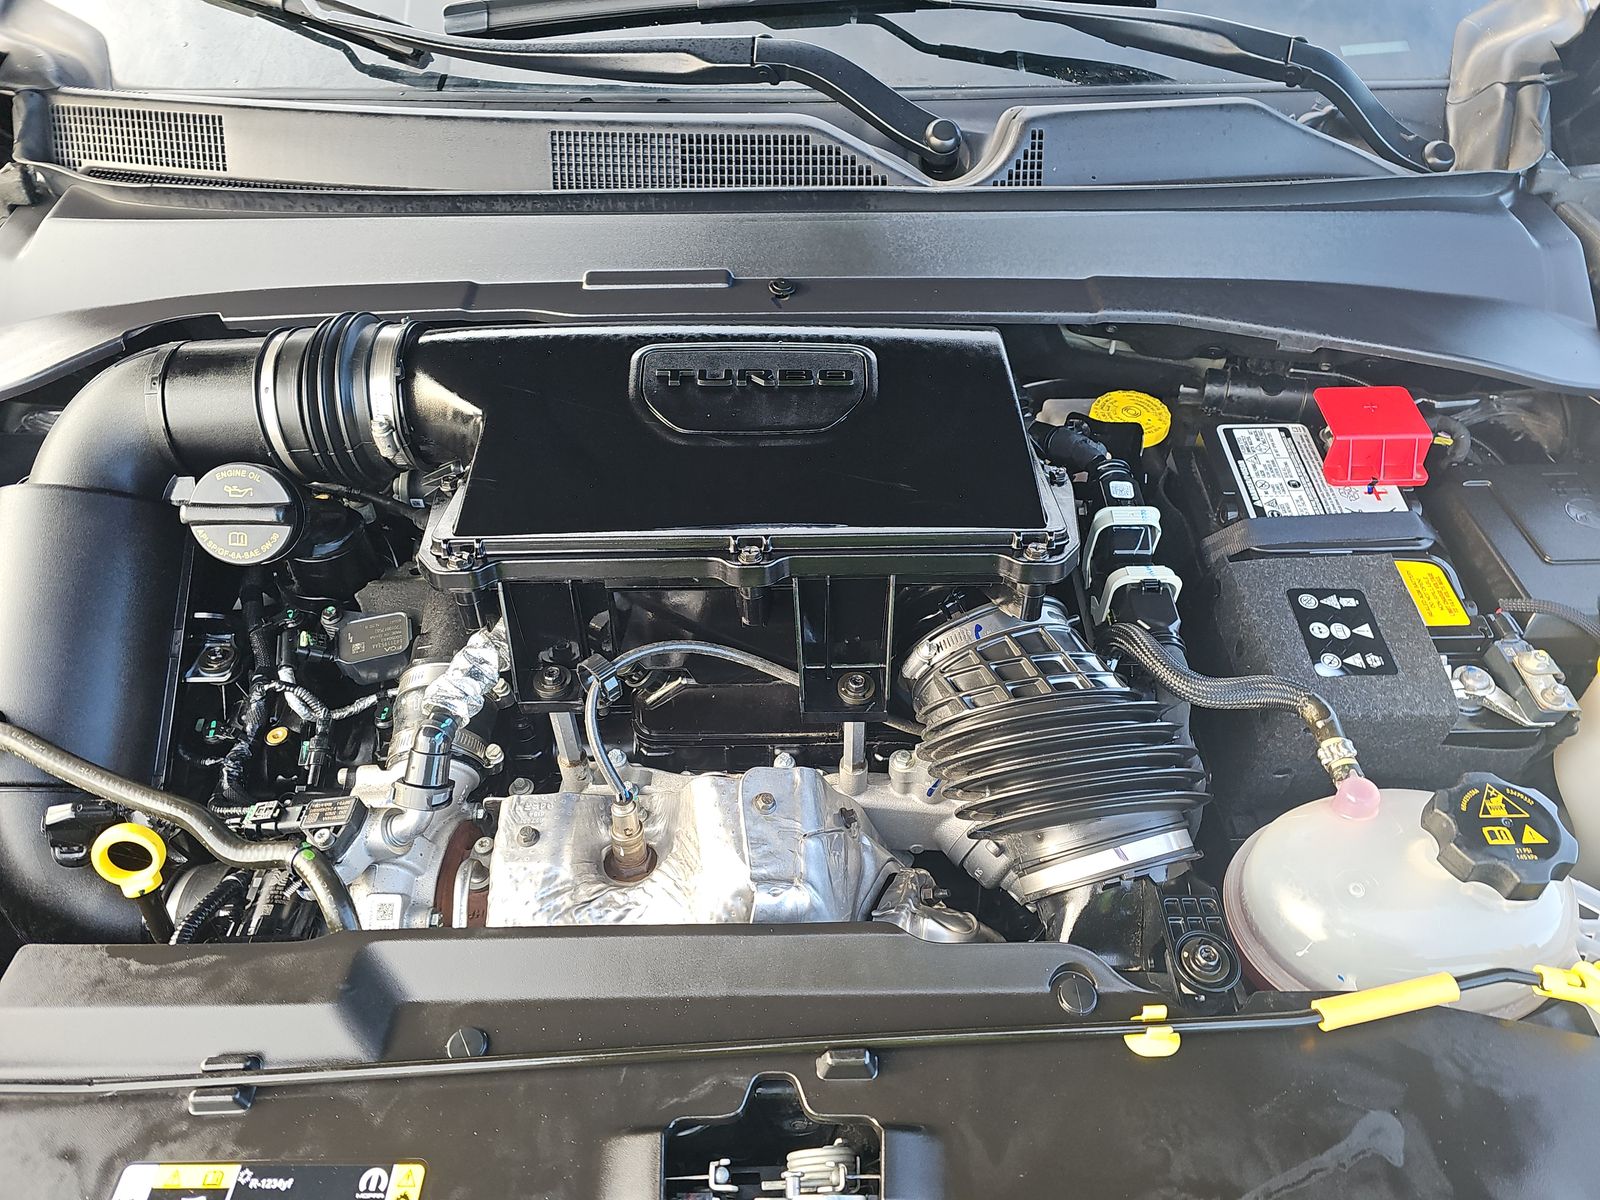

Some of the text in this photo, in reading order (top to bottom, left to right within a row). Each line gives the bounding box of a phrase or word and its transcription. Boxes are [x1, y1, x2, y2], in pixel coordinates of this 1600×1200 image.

[655, 368, 854, 386] TURBO
[215, 469, 261, 482] ENGINE OIL
[196, 528, 208, 543] API
[260, 532, 280, 552] 5W-30
[248, 1178, 294, 1192] R-1234yf
